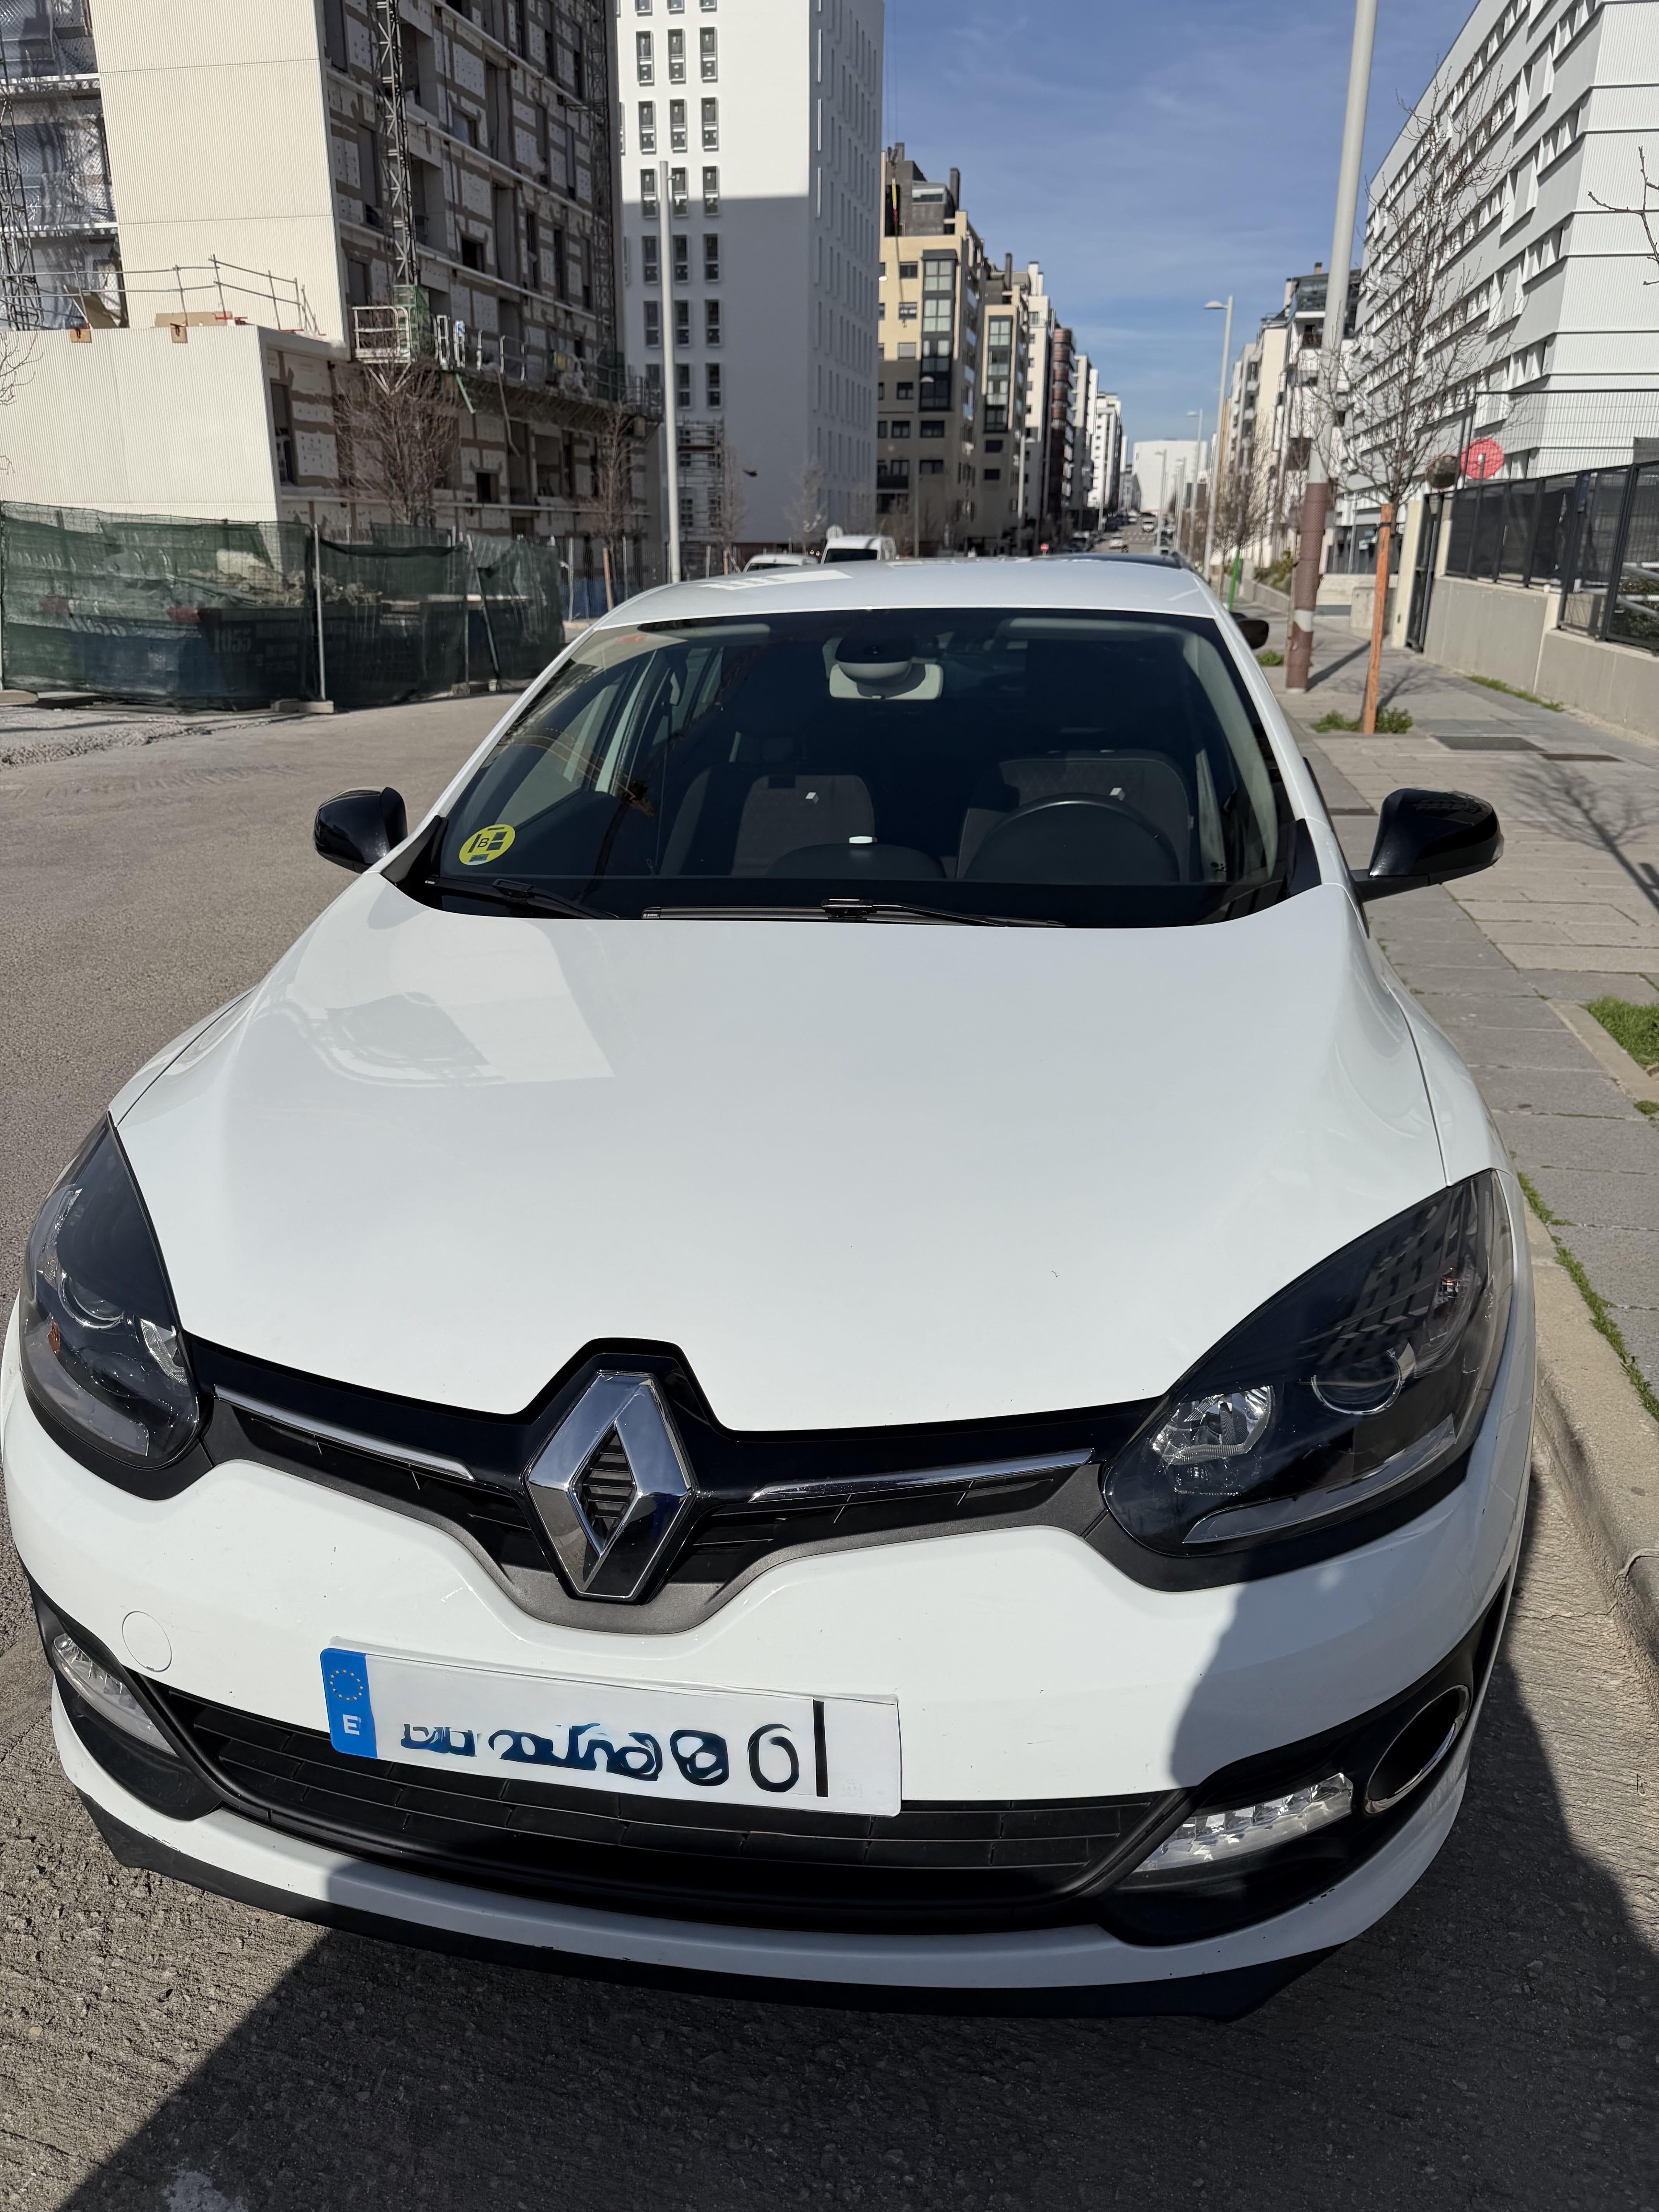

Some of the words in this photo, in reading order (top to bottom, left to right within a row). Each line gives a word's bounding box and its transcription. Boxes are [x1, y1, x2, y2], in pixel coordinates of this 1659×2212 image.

[213, 628, 252, 653] 1055
[477, 838, 489, 847] B
[342, 1714, 361, 1735] E
